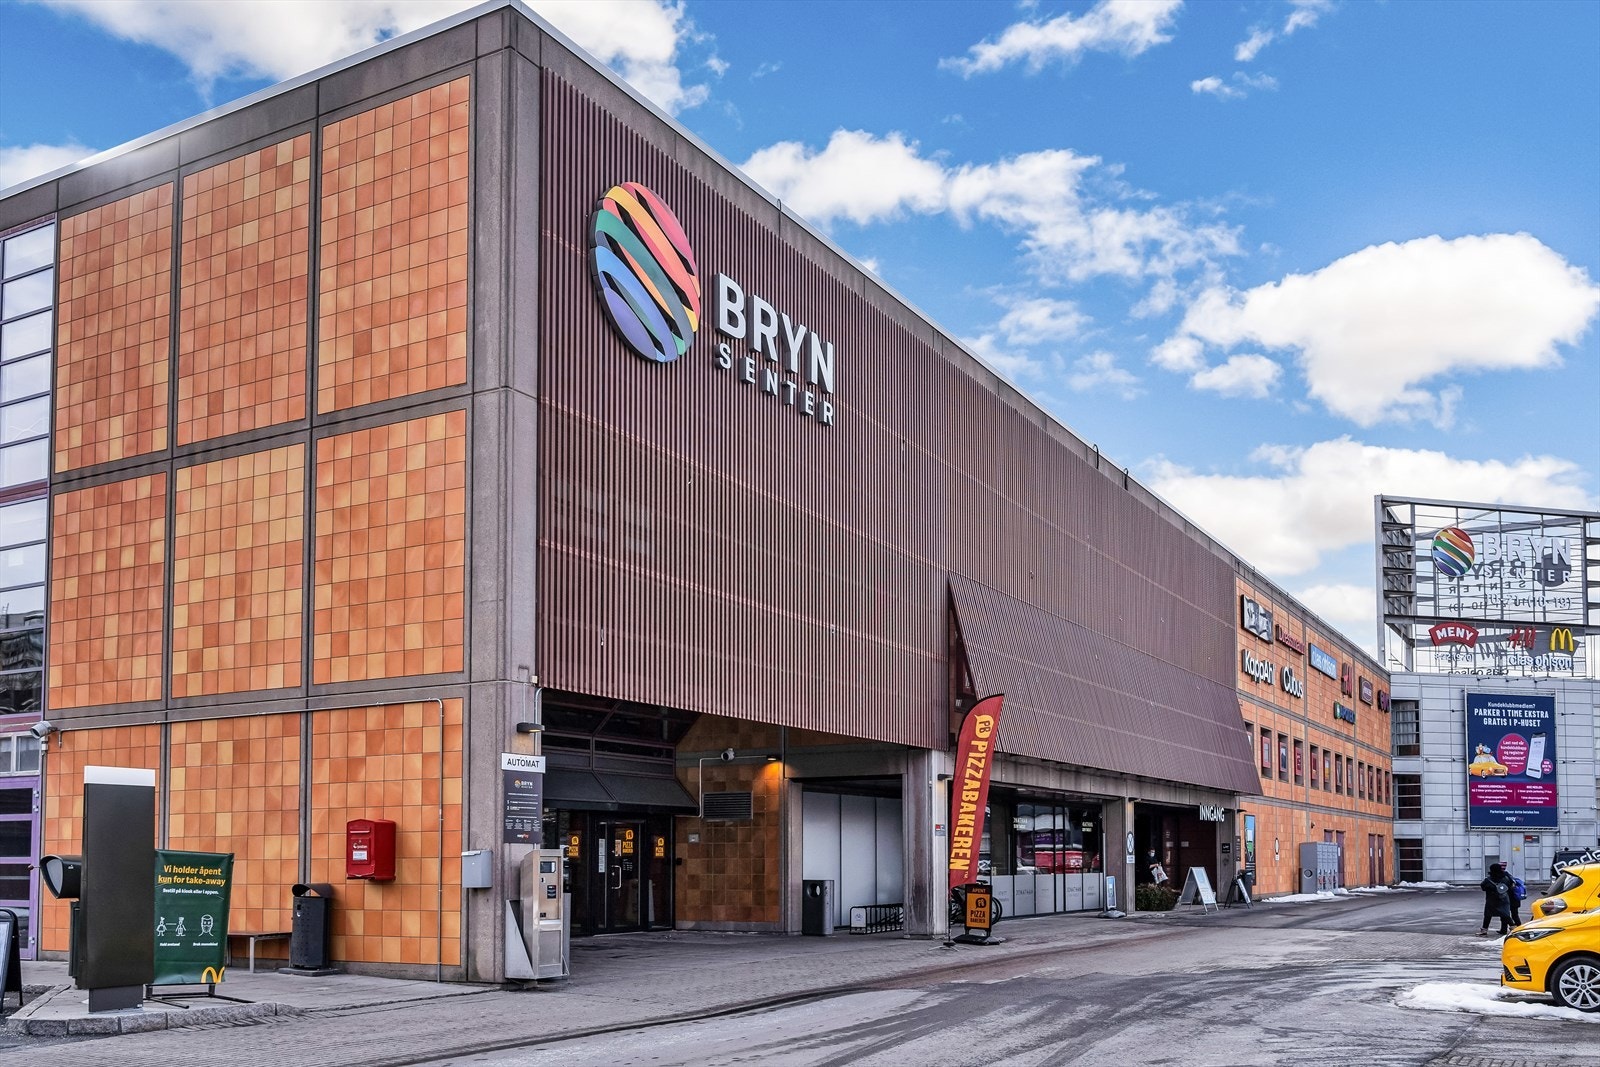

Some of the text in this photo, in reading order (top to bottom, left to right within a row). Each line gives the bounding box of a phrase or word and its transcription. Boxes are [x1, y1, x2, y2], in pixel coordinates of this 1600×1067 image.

[714, 272, 834, 394] BRYN
[714, 342, 834, 426] SENTER
[1482, 533, 1571, 566] BRYN
[1435, 627, 1474, 640] MENY
[1474, 708, 1549, 719] PARKER 1 TIME EKSTRA
[1483, 718, 1508, 726] GRATIS
[1513, 719, 1541, 727] P-HUSET
[506, 758, 540, 768] AUTOMAT
[949, 740, 988, 871] PIZZABAKEREN
[163, 864, 222, 876] Vi holder åpent
[157, 875, 226, 887] kun for take-away
[970, 909, 986, 918] PIZZA
